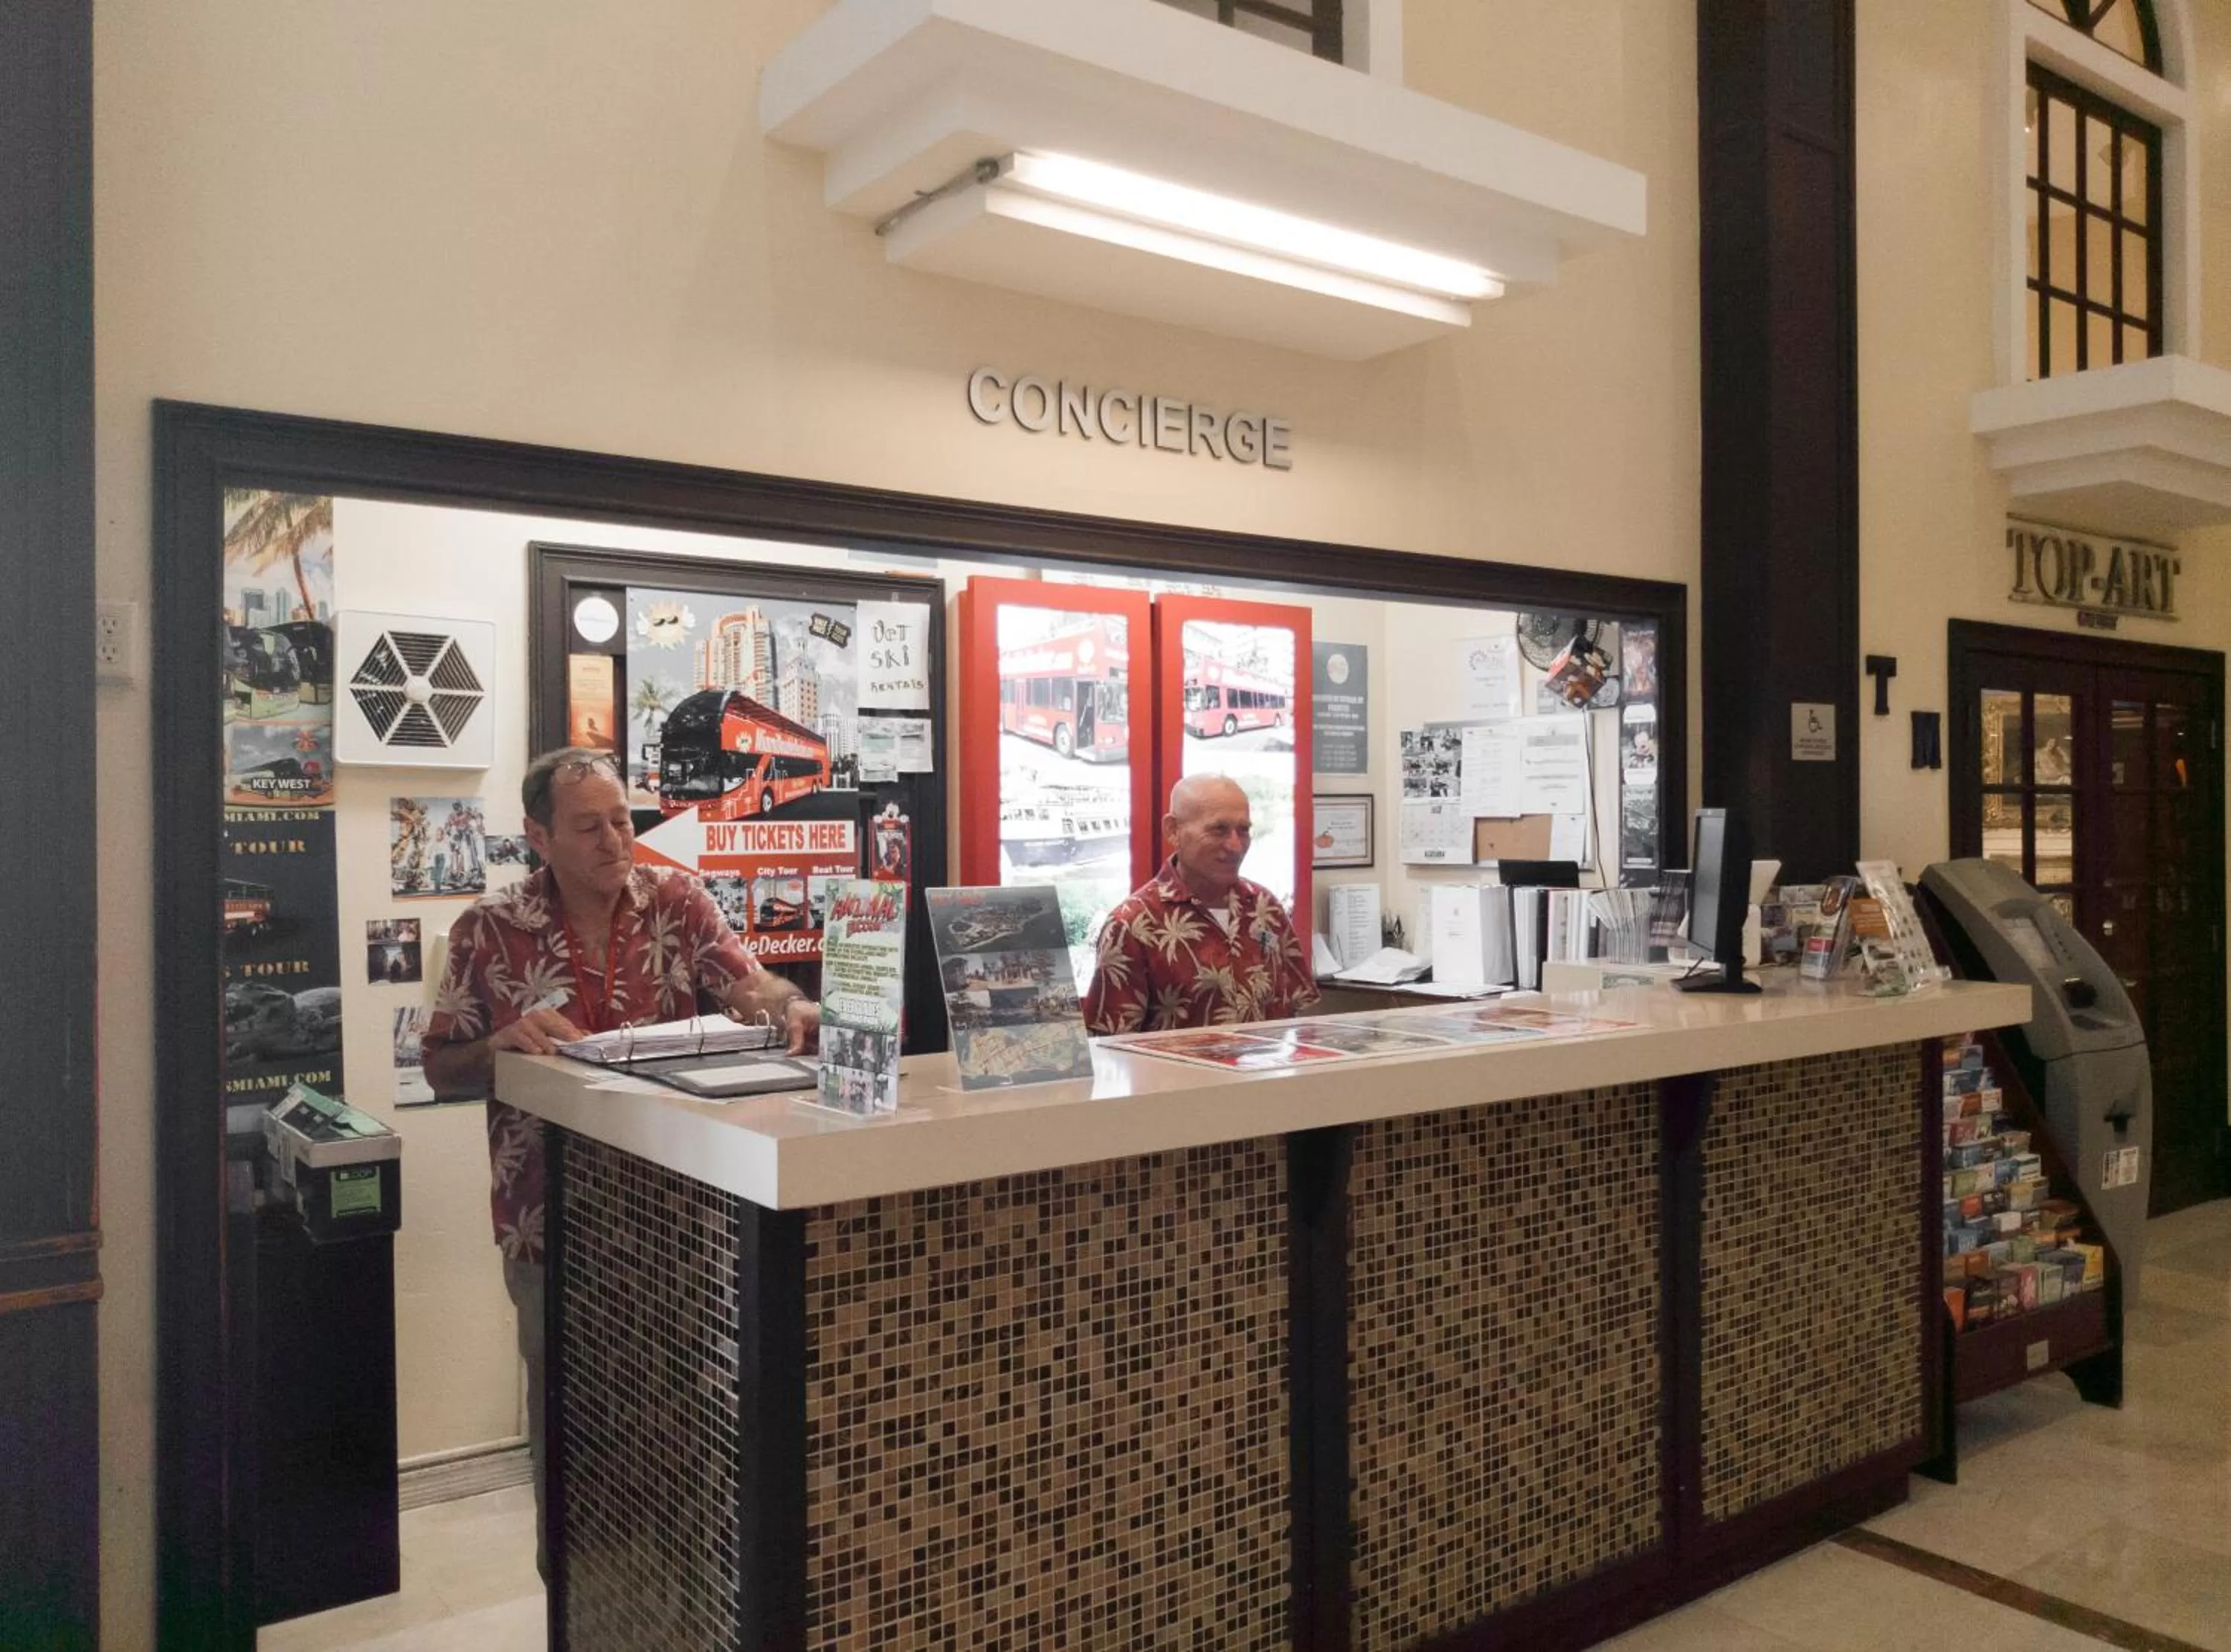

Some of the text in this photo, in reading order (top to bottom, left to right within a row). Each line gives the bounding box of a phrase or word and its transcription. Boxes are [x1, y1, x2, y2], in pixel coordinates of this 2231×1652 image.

[968, 367, 1292, 471] CONCIERGE
[252, 778, 312, 790] KEY WEST
[706, 824, 846, 851] BUY TICKETS HERE
[230, 839, 306, 854] TOUR
[757, 866, 776, 878] City
[778, 865, 799, 875] Tour
[834, 864, 855, 874] Tour
[241, 961, 310, 978] TOUR
